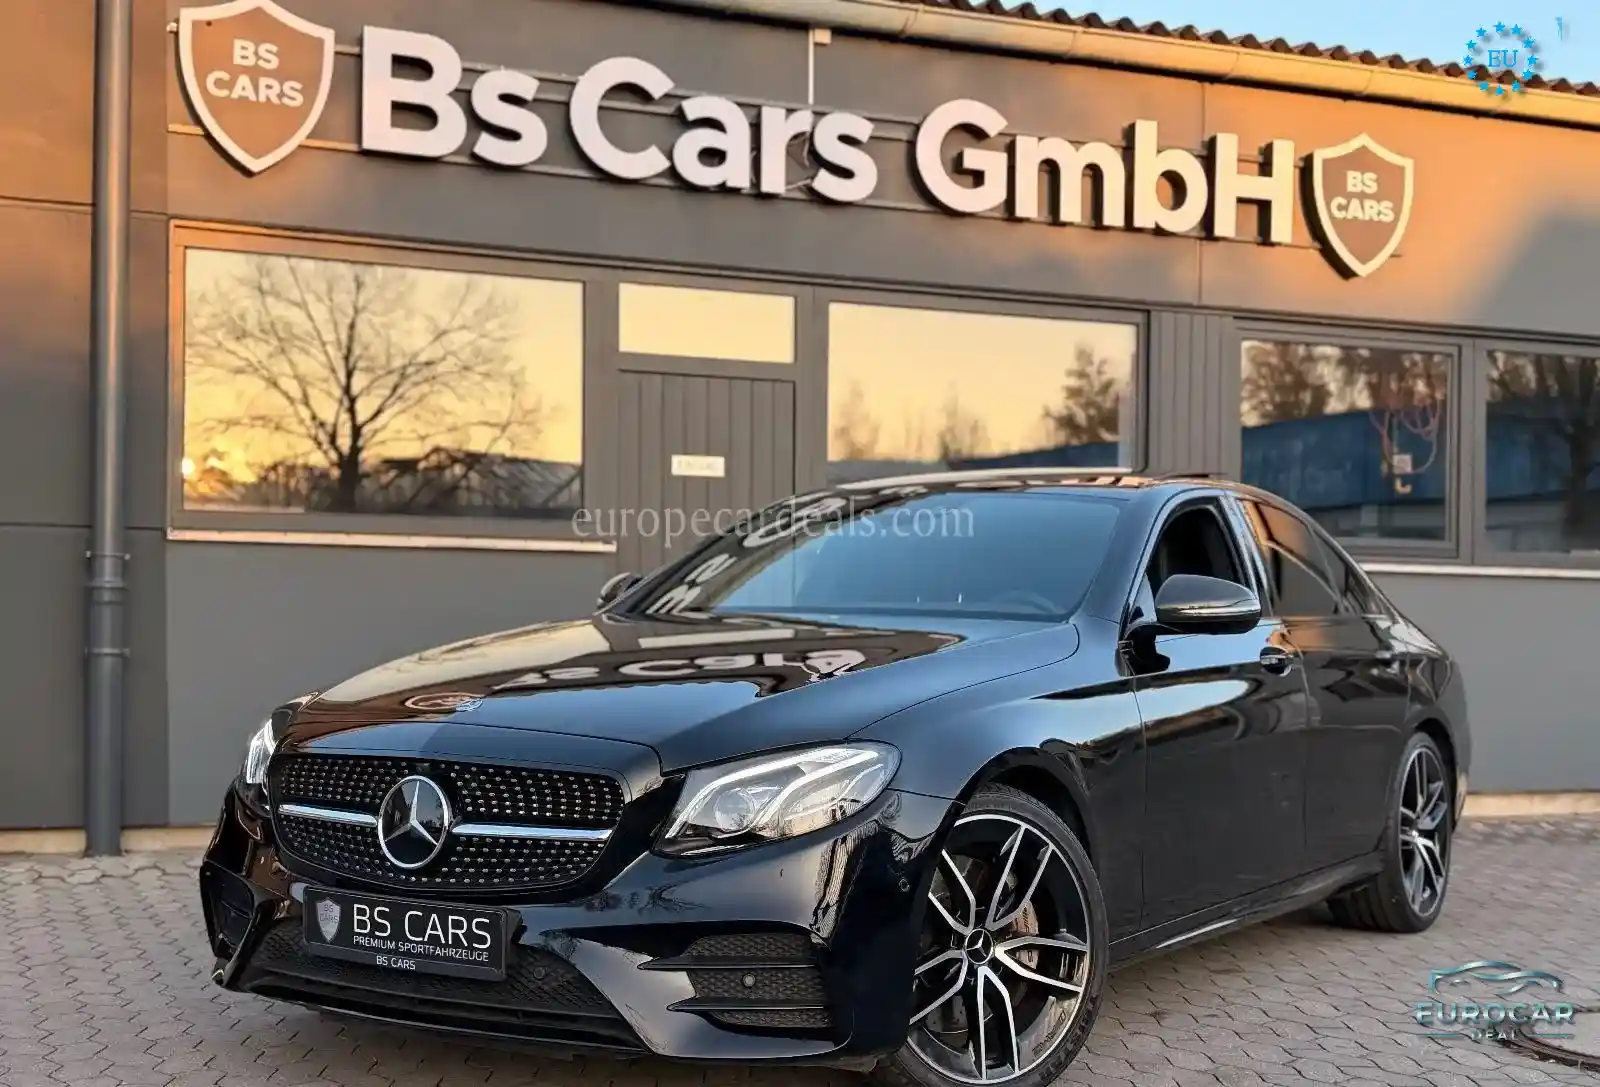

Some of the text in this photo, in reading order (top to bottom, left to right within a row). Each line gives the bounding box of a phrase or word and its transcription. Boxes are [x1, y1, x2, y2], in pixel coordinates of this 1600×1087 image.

[232, 38, 280, 70] BS
[205, 70, 304, 108] CARS
[915, 99, 1296, 244] GmbH
[1346, 170, 1378, 194] BS
[1330, 196, 1395, 223] CARS
[353, 903, 491, 949] BS CARS
[353, 935, 489, 962] PREMIUM SPORTFAHRZEUGE
[376, 955, 416, 970] BS CARS
